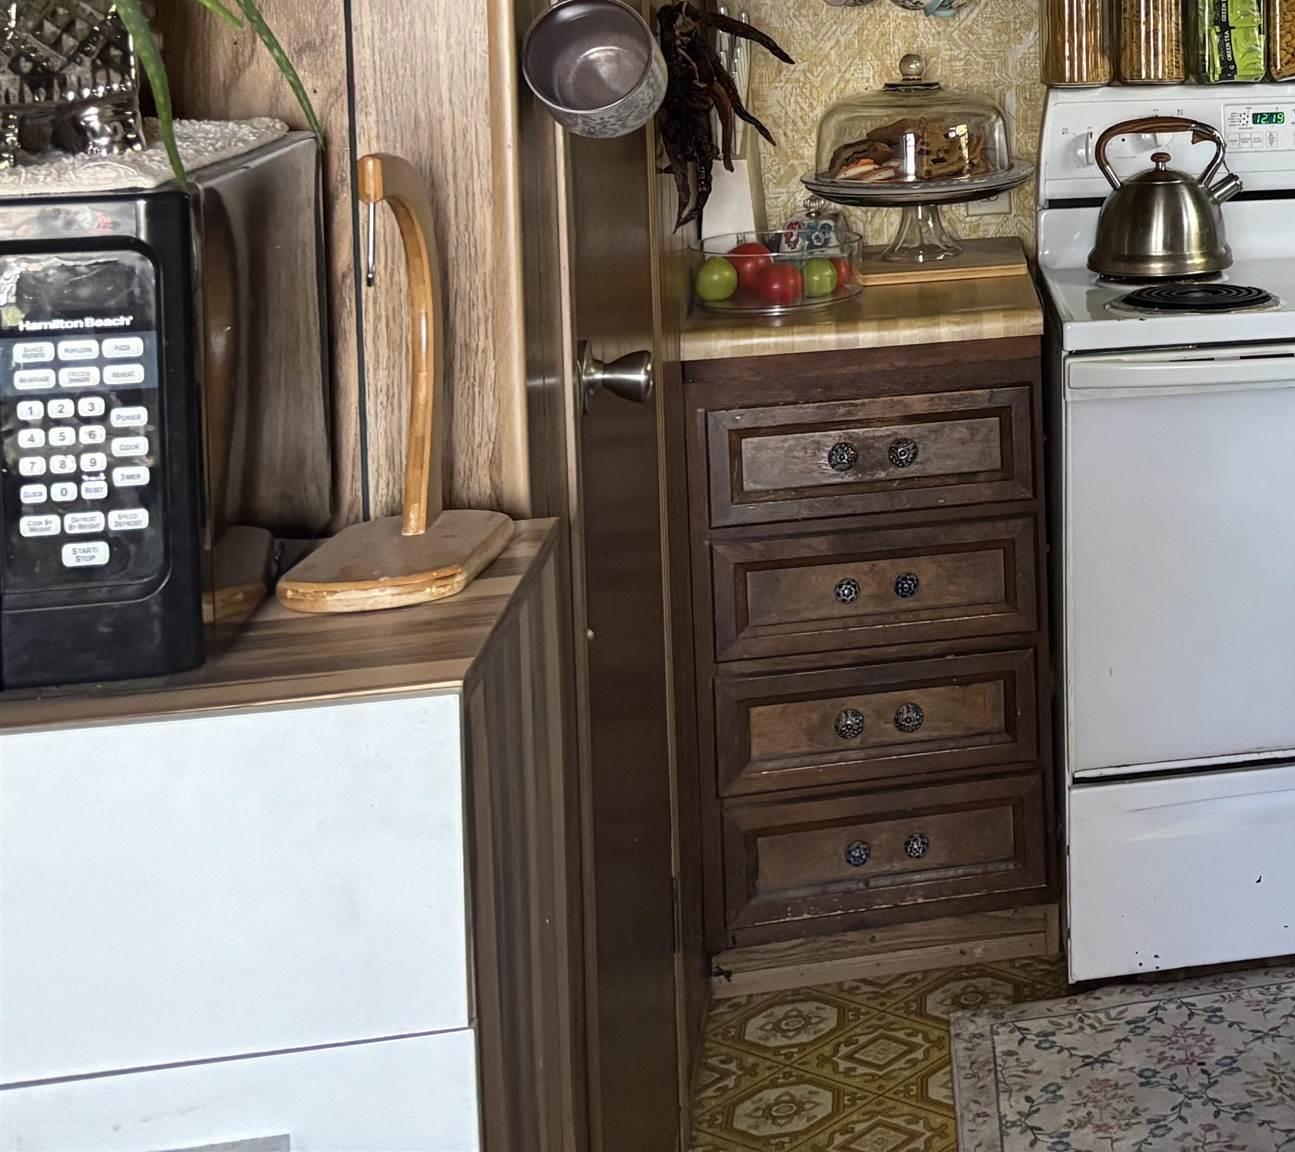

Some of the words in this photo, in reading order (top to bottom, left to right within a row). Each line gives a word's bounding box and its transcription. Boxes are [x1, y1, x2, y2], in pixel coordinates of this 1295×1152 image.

[18, 318, 84, 331] Hamilton
[84, 316, 131, 328] Beach
[28, 406, 33, 415] 1
[58, 404, 64, 414] 2
[88, 402, 95, 412] 3
[28, 434, 34, 443] 4
[58, 432, 66, 441] 5
[88, 430, 96, 439] 6
[30, 462, 36, 470] 7
[60, 460, 66, 469] 8
[90, 458, 97, 467] 9
[60, 488, 68, 497] 0
[85, 486, 103, 494] RESET
[76, 555, 96, 563] STOP
